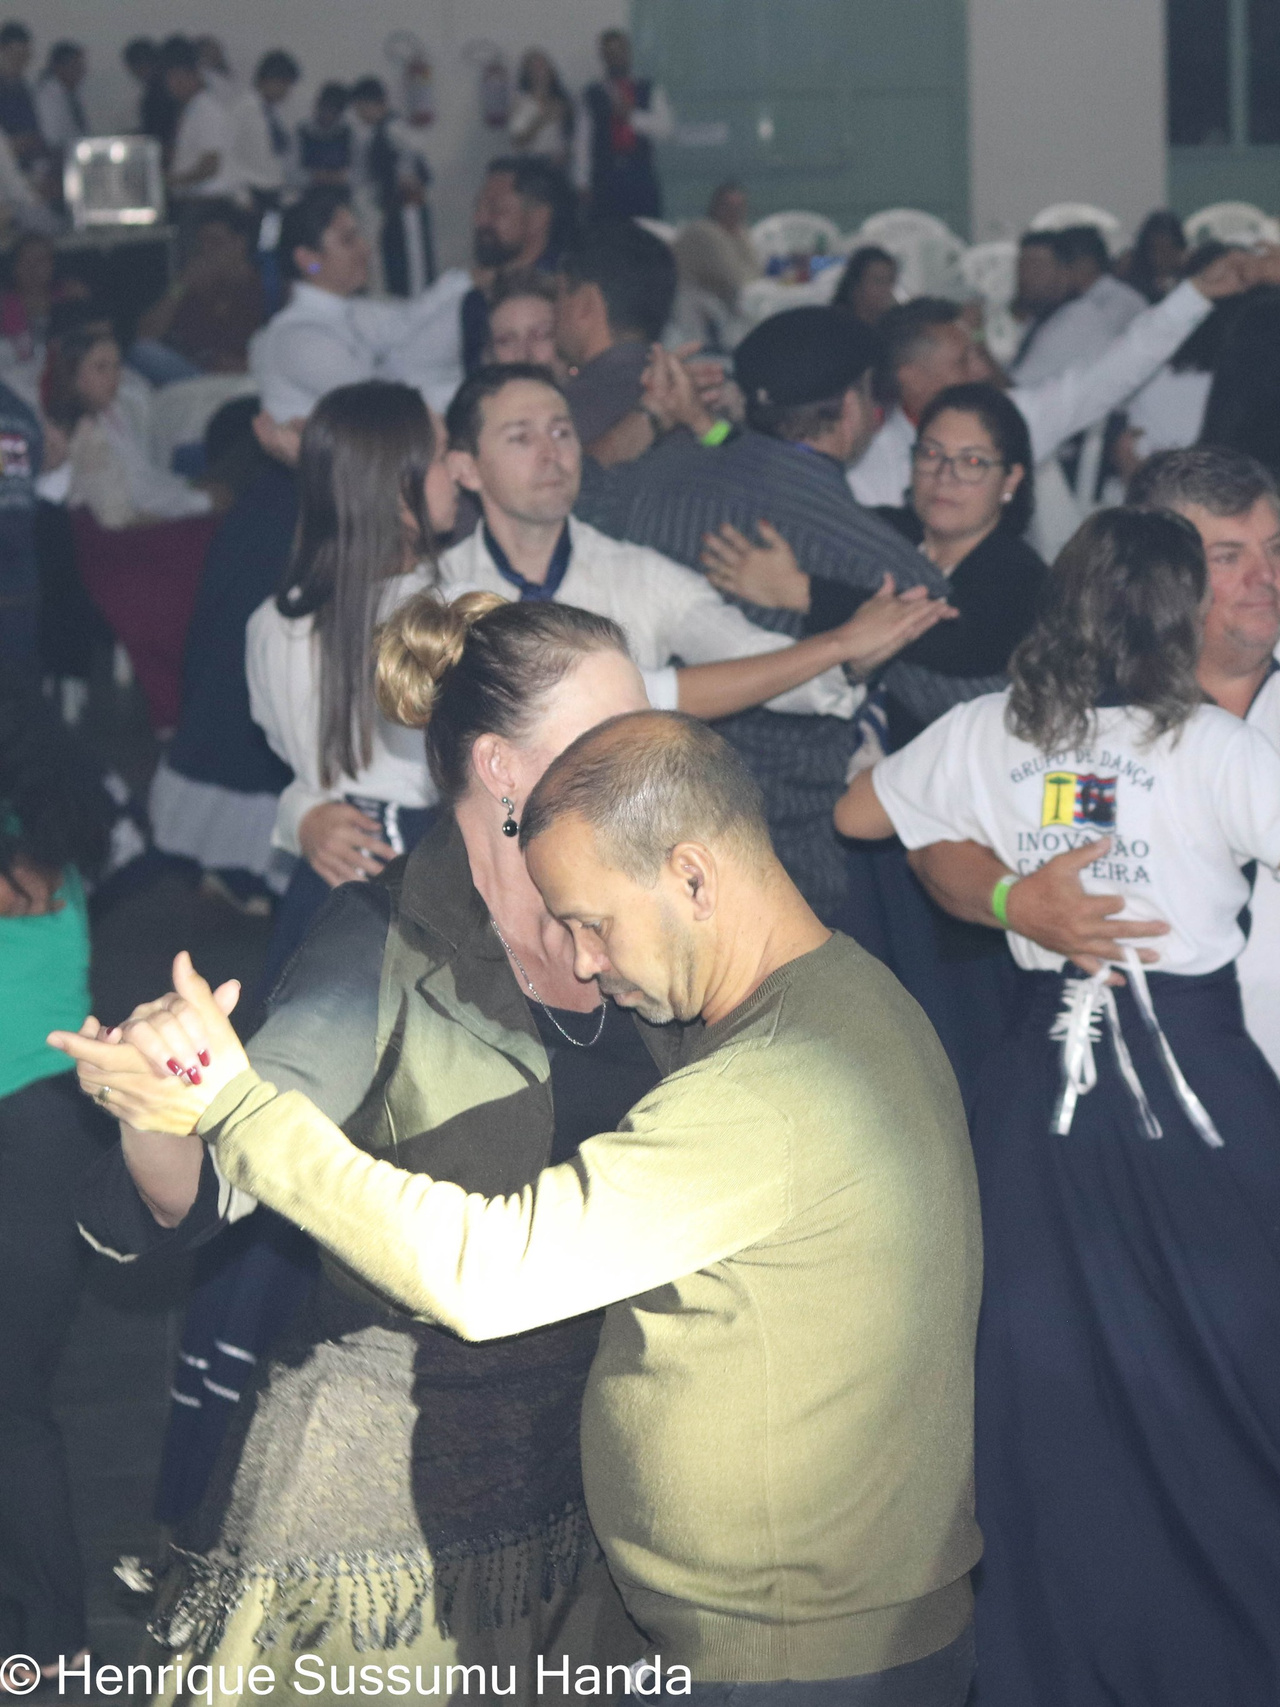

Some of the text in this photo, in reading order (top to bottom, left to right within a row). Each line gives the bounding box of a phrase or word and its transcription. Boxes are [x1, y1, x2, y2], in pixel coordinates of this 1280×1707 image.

[1075, 748, 1095, 764] DE
[1100, 750, 1156, 792] DANÇA
[1017, 831, 1150, 858] INOVAÃO
